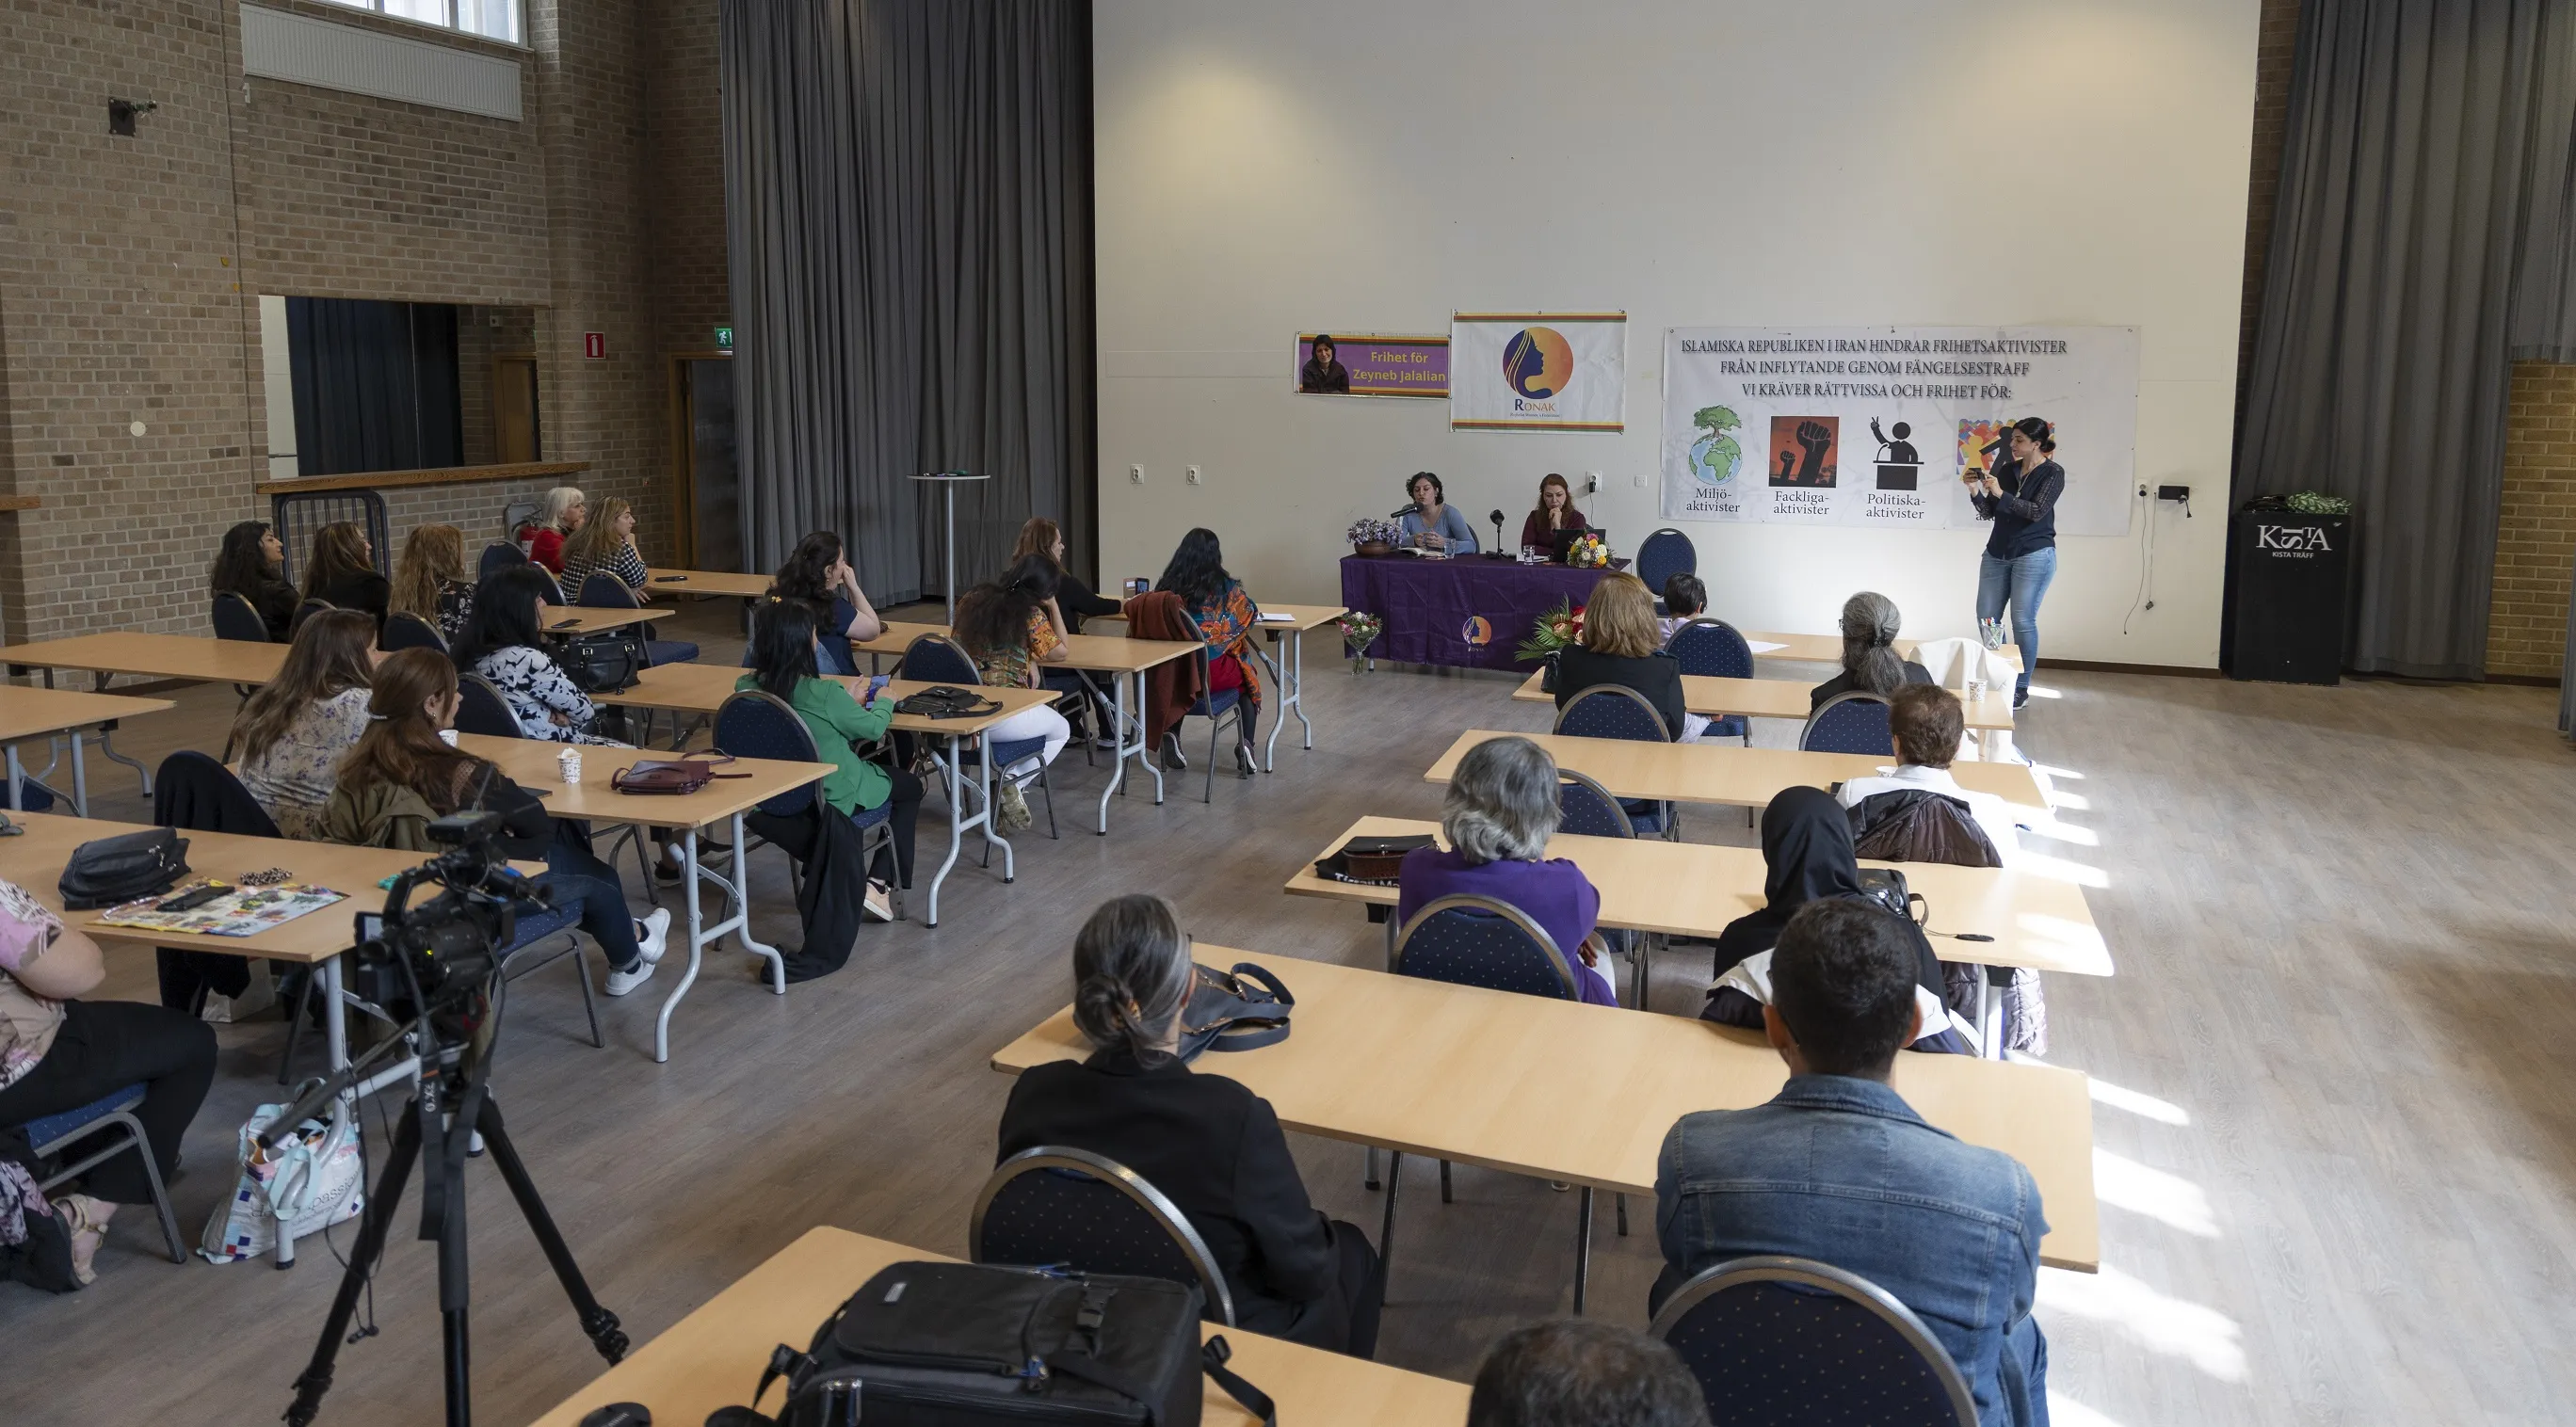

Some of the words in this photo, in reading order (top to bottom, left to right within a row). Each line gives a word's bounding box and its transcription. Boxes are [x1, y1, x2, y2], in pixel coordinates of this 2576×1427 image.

[1681, 340, 1745, 352] ISLAMISKA
[1747, 340, 1824, 352] REPUBLIKEN
[1827, 340, 1831, 352] I
[1834, 340, 1866, 352] IRAN
[1869, 340, 1930, 352] HINDRAR
[1932, 340, 2067, 353] FRIHETSAKTIVISTER
[1371, 351, 1407, 362] Frihet
[1410, 352, 1428, 363] för
[1720, 358, 1756, 373] FRÅN
[1759, 361, 1844, 374] INFLYTANDE
[1847, 361, 1901, 374] GENOM
[1905, 359, 2030, 376] FÄNGELSESTRAFF
[1353, 369, 1397, 382] Zeyneb
[1399, 370, 1445, 383] Jalalian
[1742, 383, 1755, 395] VI
[1759, 381, 1811, 395] KRÄVER
[1813, 381, 1888, 396] RÄTTVISSA
[1892, 384, 1923, 397] OCH
[1926, 385, 1976, 398] FRIHET
[1980, 383, 2012, 398] FÖR:
[1515, 399, 1556, 411] RONAK
[1695, 489, 1732, 502] Miljö-
[1775, 491, 1829, 505] Fackliga-
[1866, 494, 1926, 505] Politiska-
[1686, 501, 1741, 513] aktivister
[1773, 504, 1829, 515] aktivister
[1866, 506, 1924, 519] aktivister
